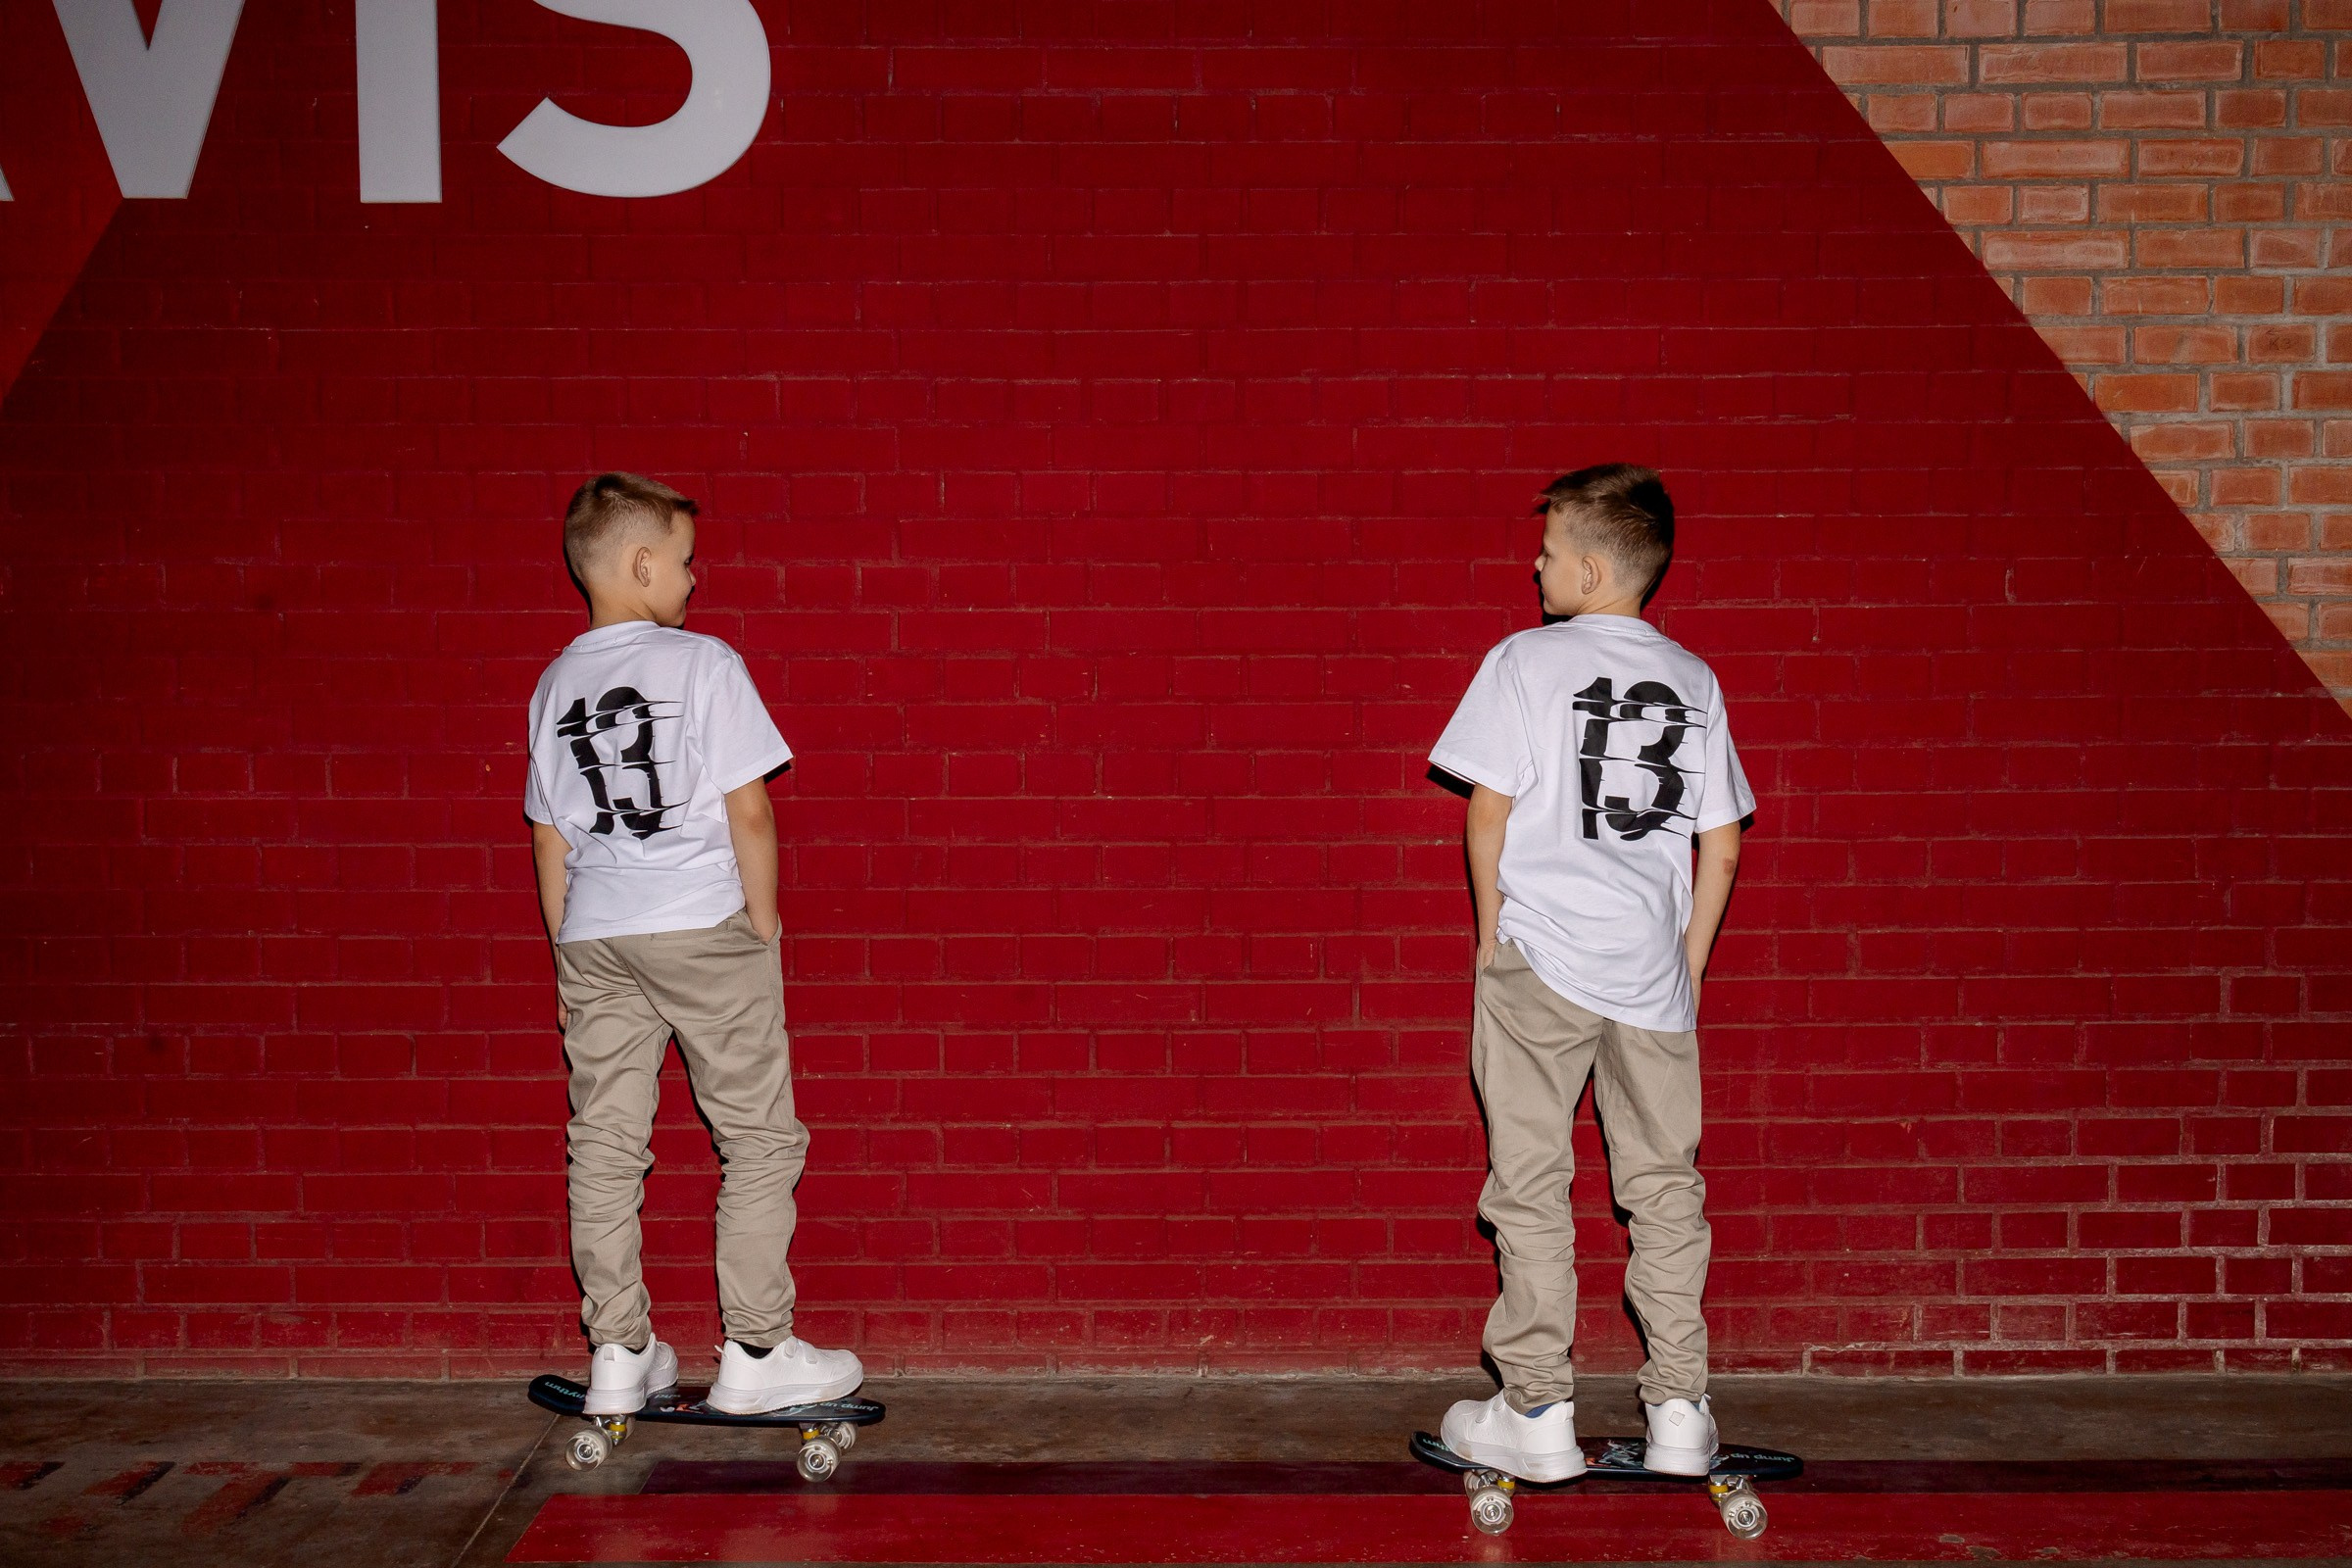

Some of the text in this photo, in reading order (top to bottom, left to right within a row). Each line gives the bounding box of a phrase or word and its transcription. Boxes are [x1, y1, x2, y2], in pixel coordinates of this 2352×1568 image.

[0, 0, 772, 203] VIS
[557, 686, 690, 840] 13
[1572, 676, 1708, 841] 13
